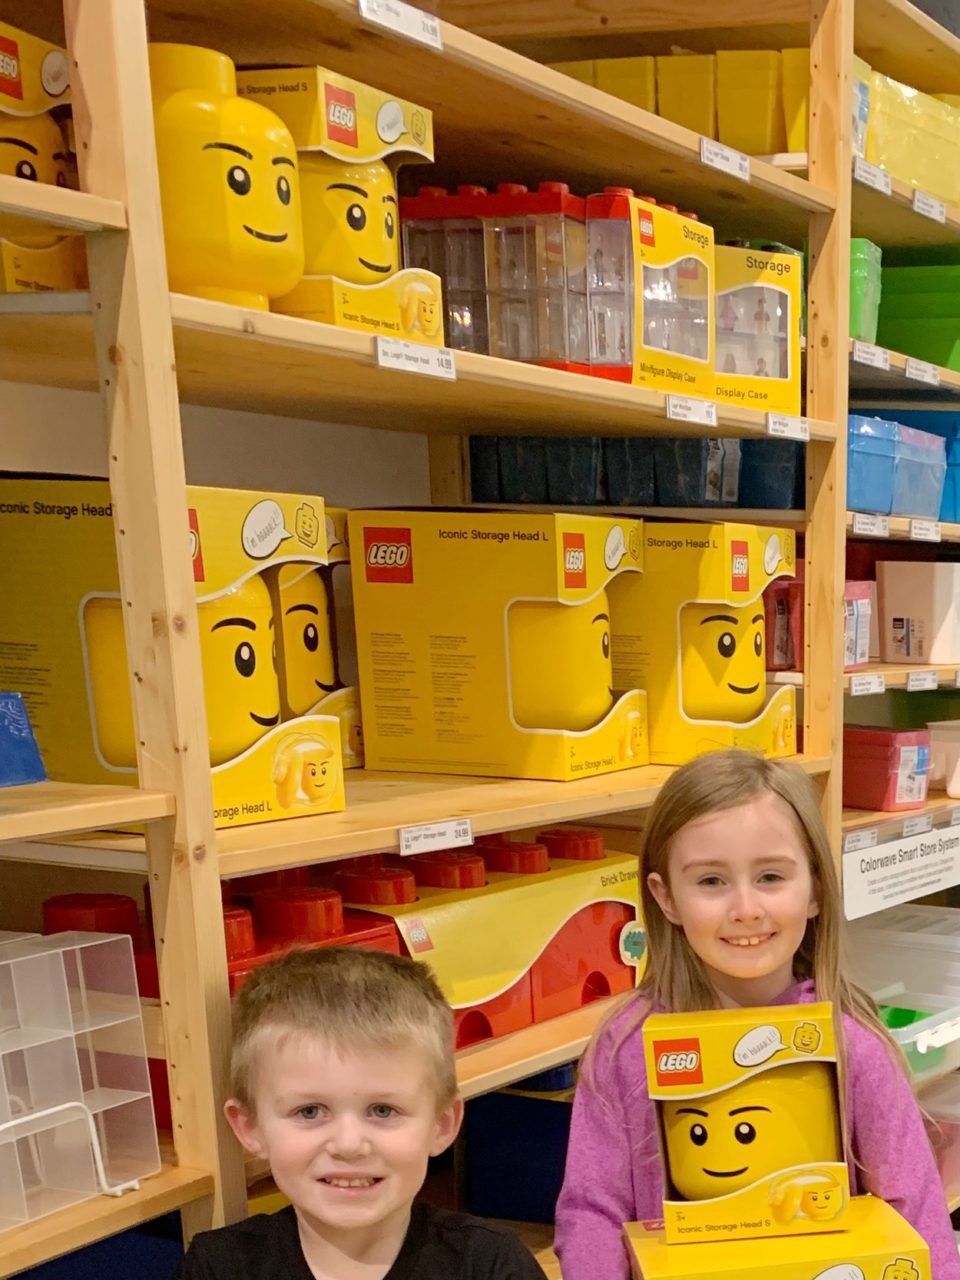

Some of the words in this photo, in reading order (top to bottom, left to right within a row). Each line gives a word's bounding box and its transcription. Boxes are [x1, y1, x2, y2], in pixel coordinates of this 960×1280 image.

[246, 84, 276, 96] Storage
[279, 83, 300, 93] Head
[329, 102, 354, 128] LEGO
[682, 225, 709, 249] Storage
[746, 256, 791, 276] Storage
[342, 311, 359, 321] Iconic
[360, 314, 381, 328] Storage
[381, 320, 393, 330] Head
[640, 362, 665, 377] Minifigure
[666, 368, 683, 382] Display
[684, 372, 696, 383] Case
[716, 386, 745, 399] Display
[748, 389, 768, 399] Case
[33, 502, 79, 519] Storage
[81, 503, 113, 517] Head
[439, 528, 468, 540] Iconic
[470, 529, 510, 543] Storage
[513, 530, 540, 541] Head
[543, 531, 549, 541] L
[647, 537, 683, 549] Storage
[685, 539, 710, 549] Head
[713, 540, 719, 549] L
[369, 544, 408, 566] LEGO
[565, 548, 584, 572] LEGO
[732, 554, 748, 577] LEGO
[584, 759, 601, 770] Storage
[242, 801, 265, 815] Head
[267, 800, 273, 811] L
[860, 853, 897, 874] Colorwave
[898, 845, 919, 863] Smart
[920, 842, 937, 858] Store
[938, 836, 960, 856] System
[600, 873, 618, 888] Brick
[658, 1052, 699, 1073] LEGO
[677, 1223, 703, 1234] Iconic
[705, 1221, 738, 1233] Storage
[740, 1219, 763, 1230] Head
[765, 1219, 771, 1227] S
